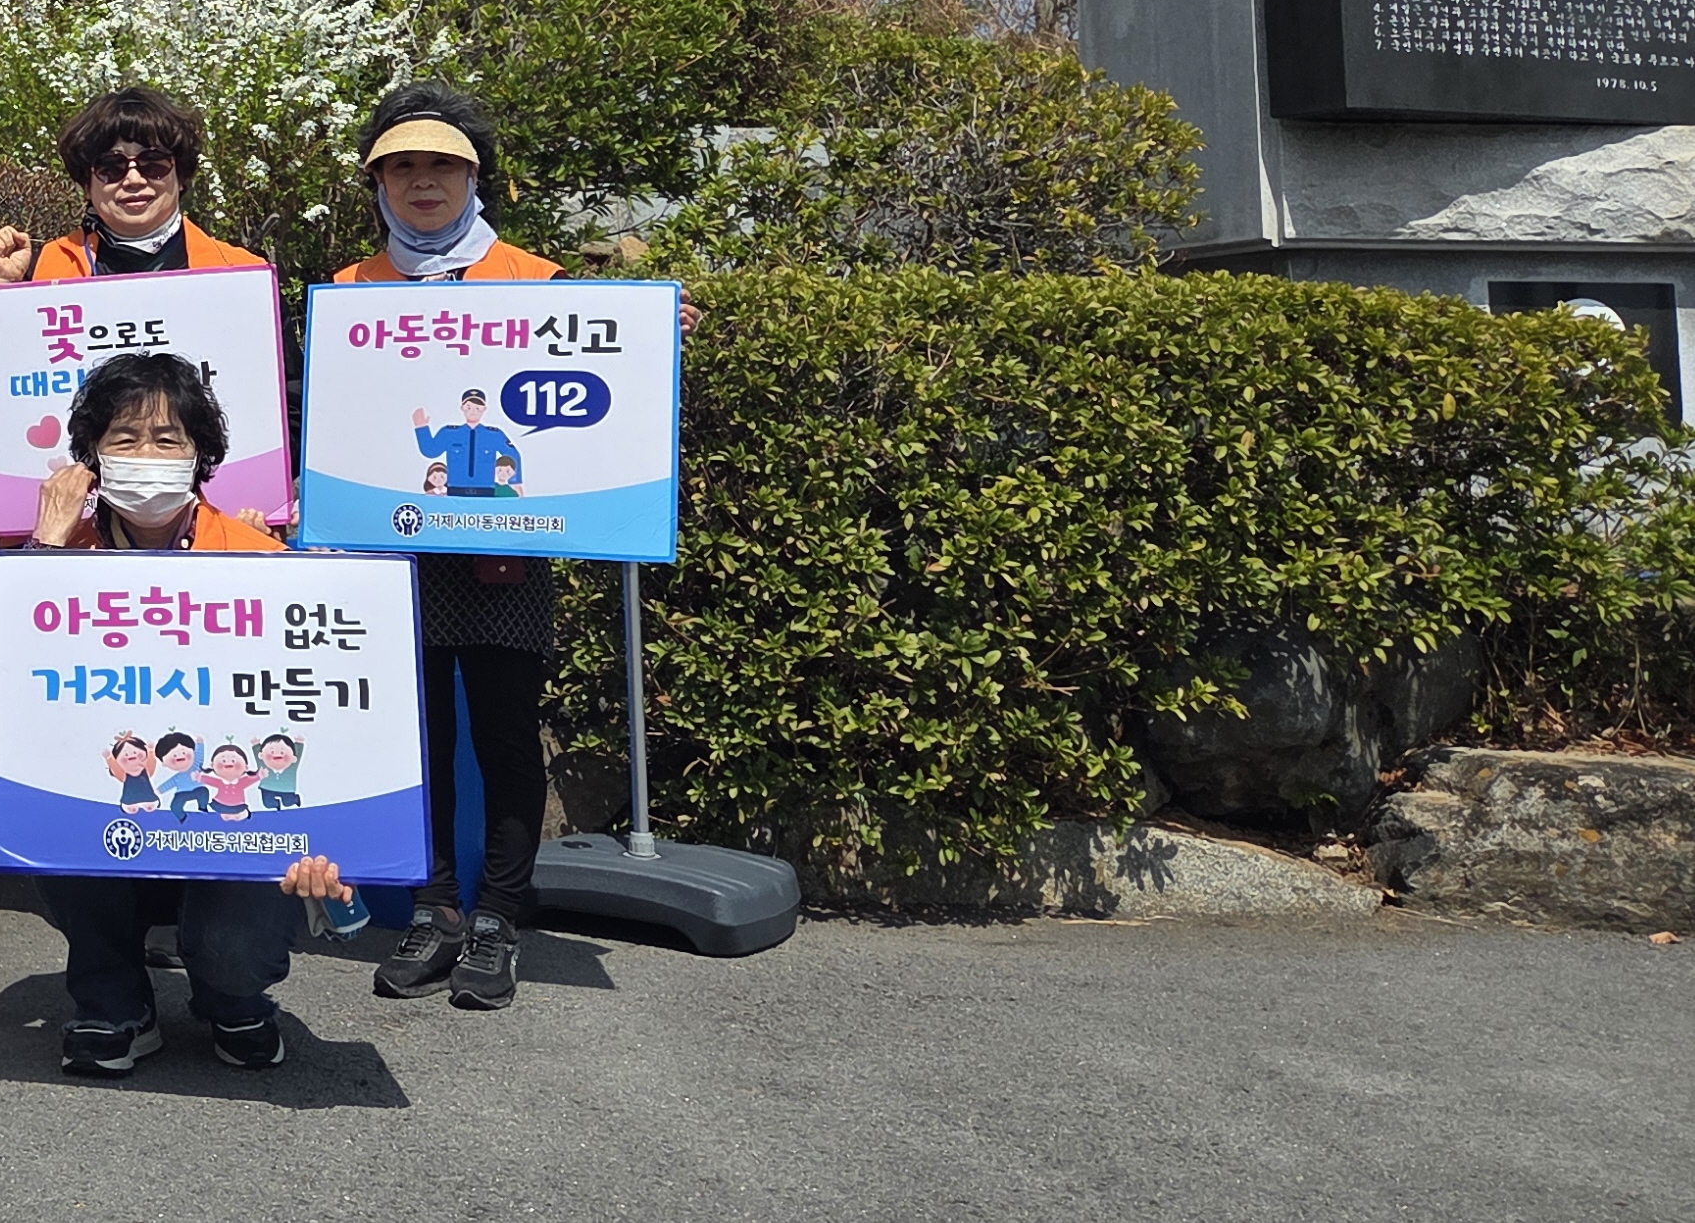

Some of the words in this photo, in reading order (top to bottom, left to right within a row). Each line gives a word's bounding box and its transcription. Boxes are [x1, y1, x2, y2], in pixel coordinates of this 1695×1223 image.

[37, 305, 169, 364] 꽃으로도
[348, 310, 622, 359] 아동학대신고
[10, 370, 86, 397] 때리
[519, 381, 588, 418] 112
[427, 513, 564, 533] 거제시아동위원협의회
[32, 586, 264, 648] 아동학대
[285, 603, 367, 650] 없는
[31, 665, 210, 706] 거제시
[233, 667, 370, 722] 만들기
[146, 830, 308, 854] 거제시아동위원협의회
